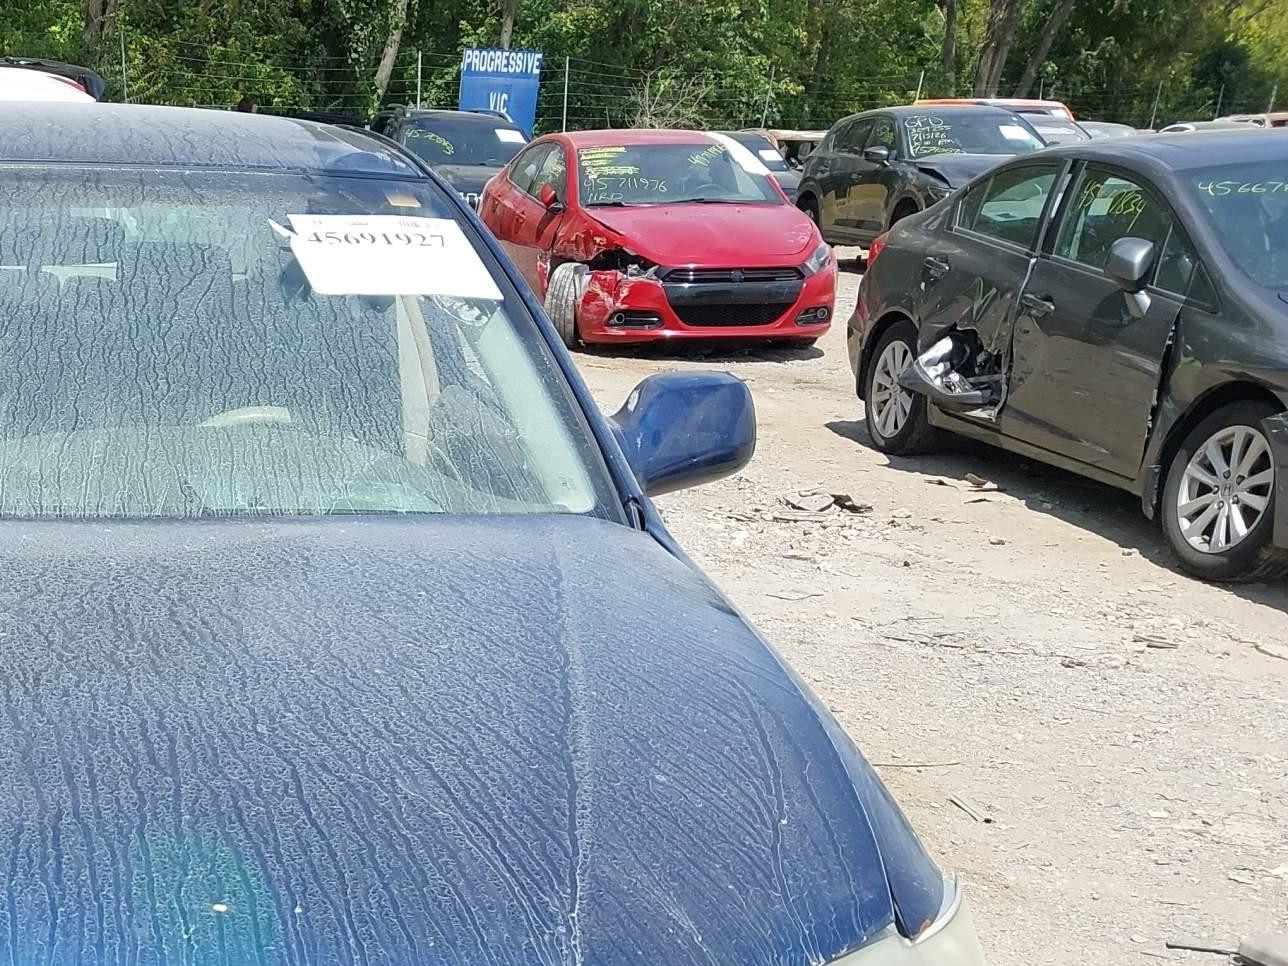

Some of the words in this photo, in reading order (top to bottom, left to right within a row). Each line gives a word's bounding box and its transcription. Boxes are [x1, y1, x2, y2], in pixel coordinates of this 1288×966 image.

[463, 50, 543, 74] PROGRESSIVE
[489, 91, 509, 113] VIC
[307, 231, 445, 248] 45691927
